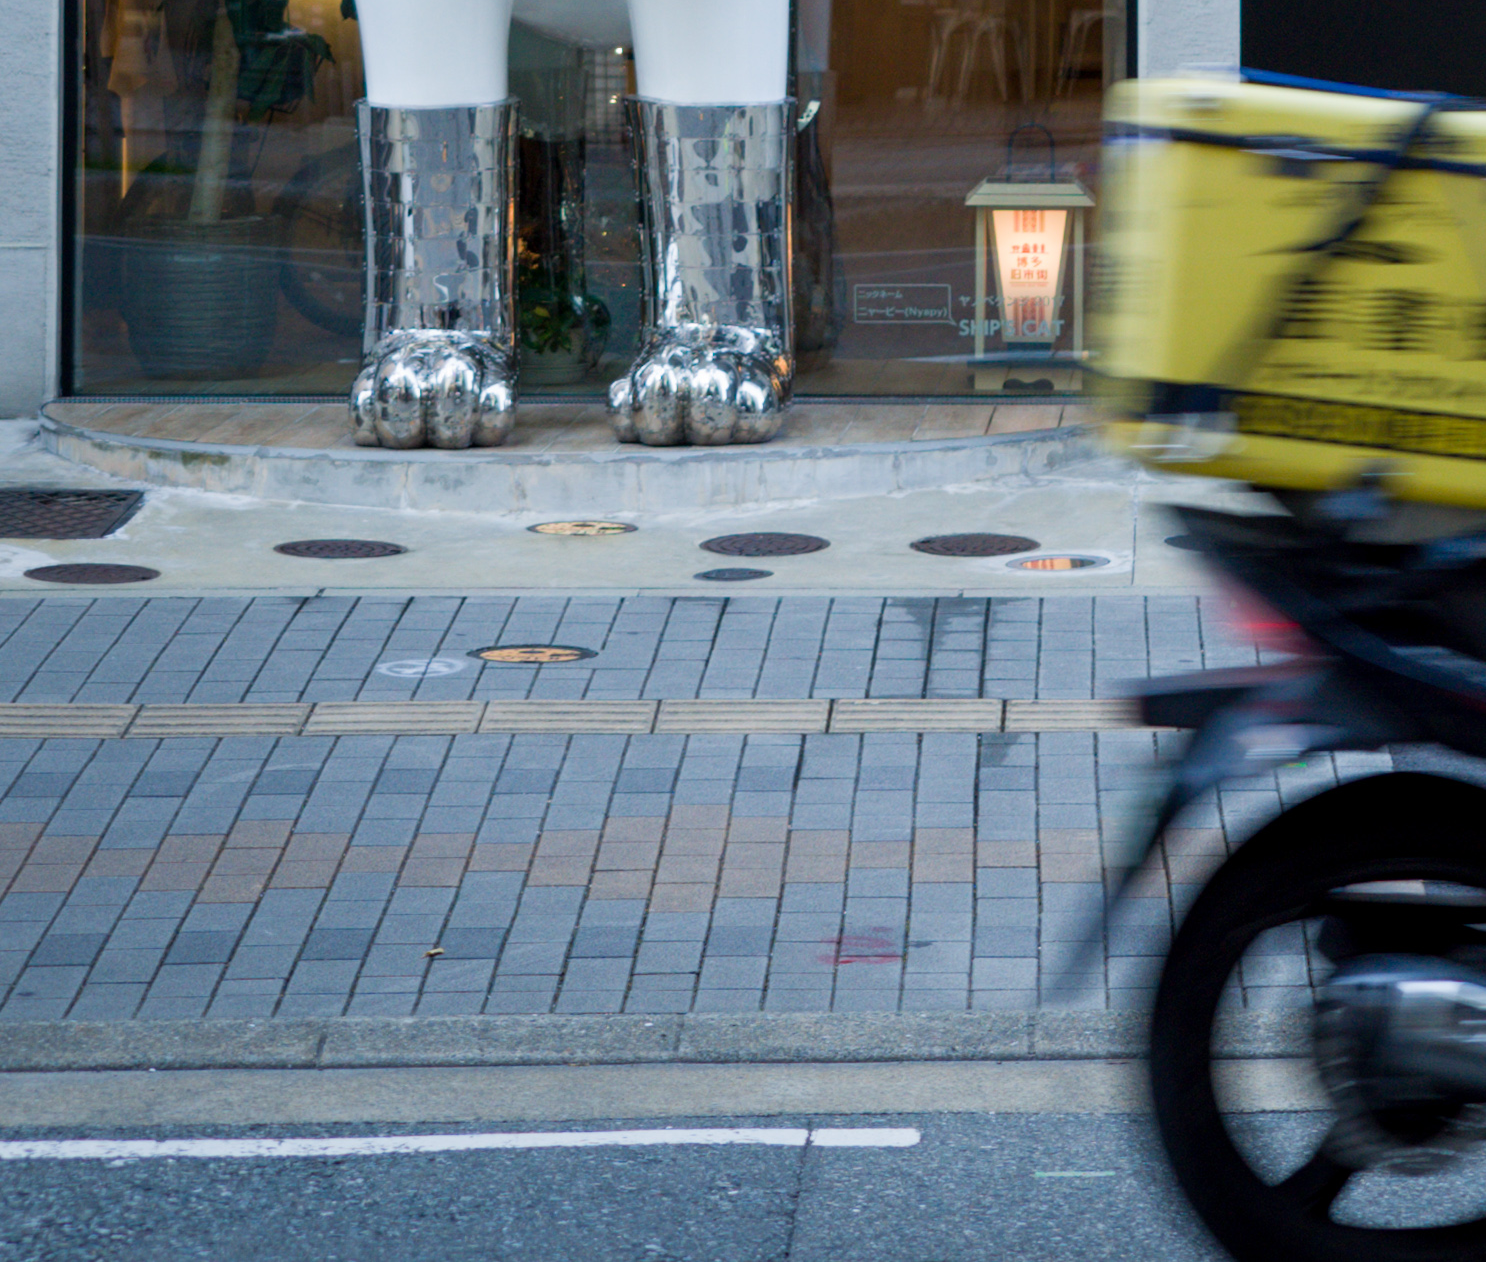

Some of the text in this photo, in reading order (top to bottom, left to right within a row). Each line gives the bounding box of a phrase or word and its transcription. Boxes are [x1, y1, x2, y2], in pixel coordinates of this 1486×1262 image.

[858, 290, 903, 299] ニックネーム
[958, 319, 1066, 337] SHIP'S CAT
